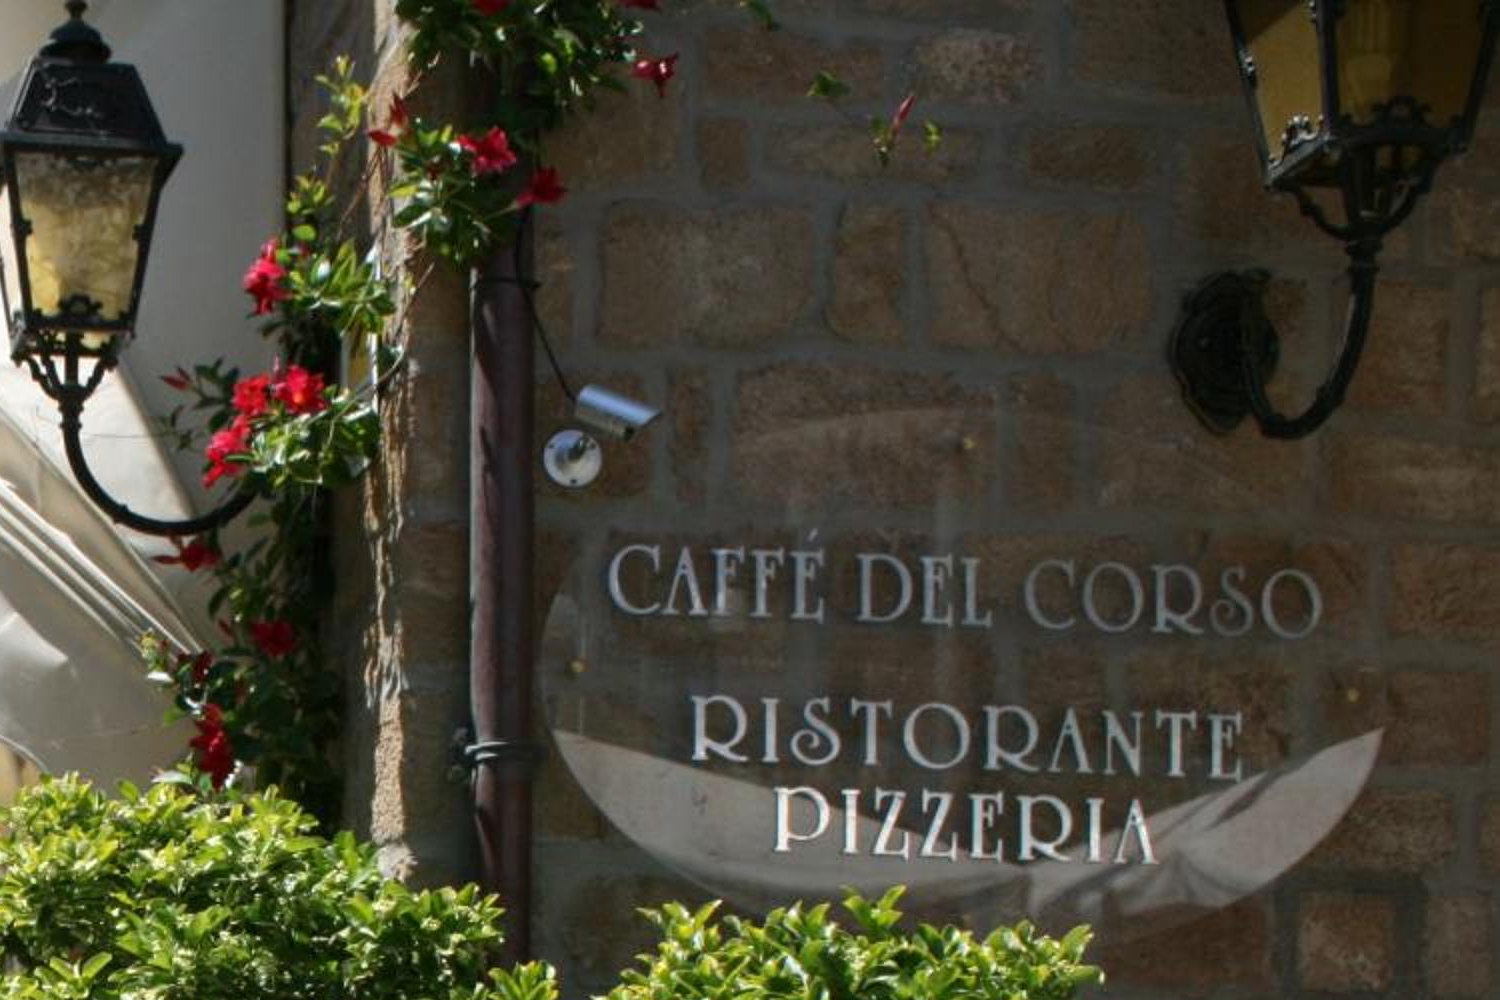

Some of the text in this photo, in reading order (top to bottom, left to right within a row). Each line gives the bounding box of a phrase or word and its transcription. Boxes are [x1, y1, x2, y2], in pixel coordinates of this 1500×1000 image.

[608, 530, 1324, 640] CAFFÉ DEL CORSO
[690, 693, 1245, 781] RISTORANTE
[773, 784, 1160, 866] PIZZERIA
